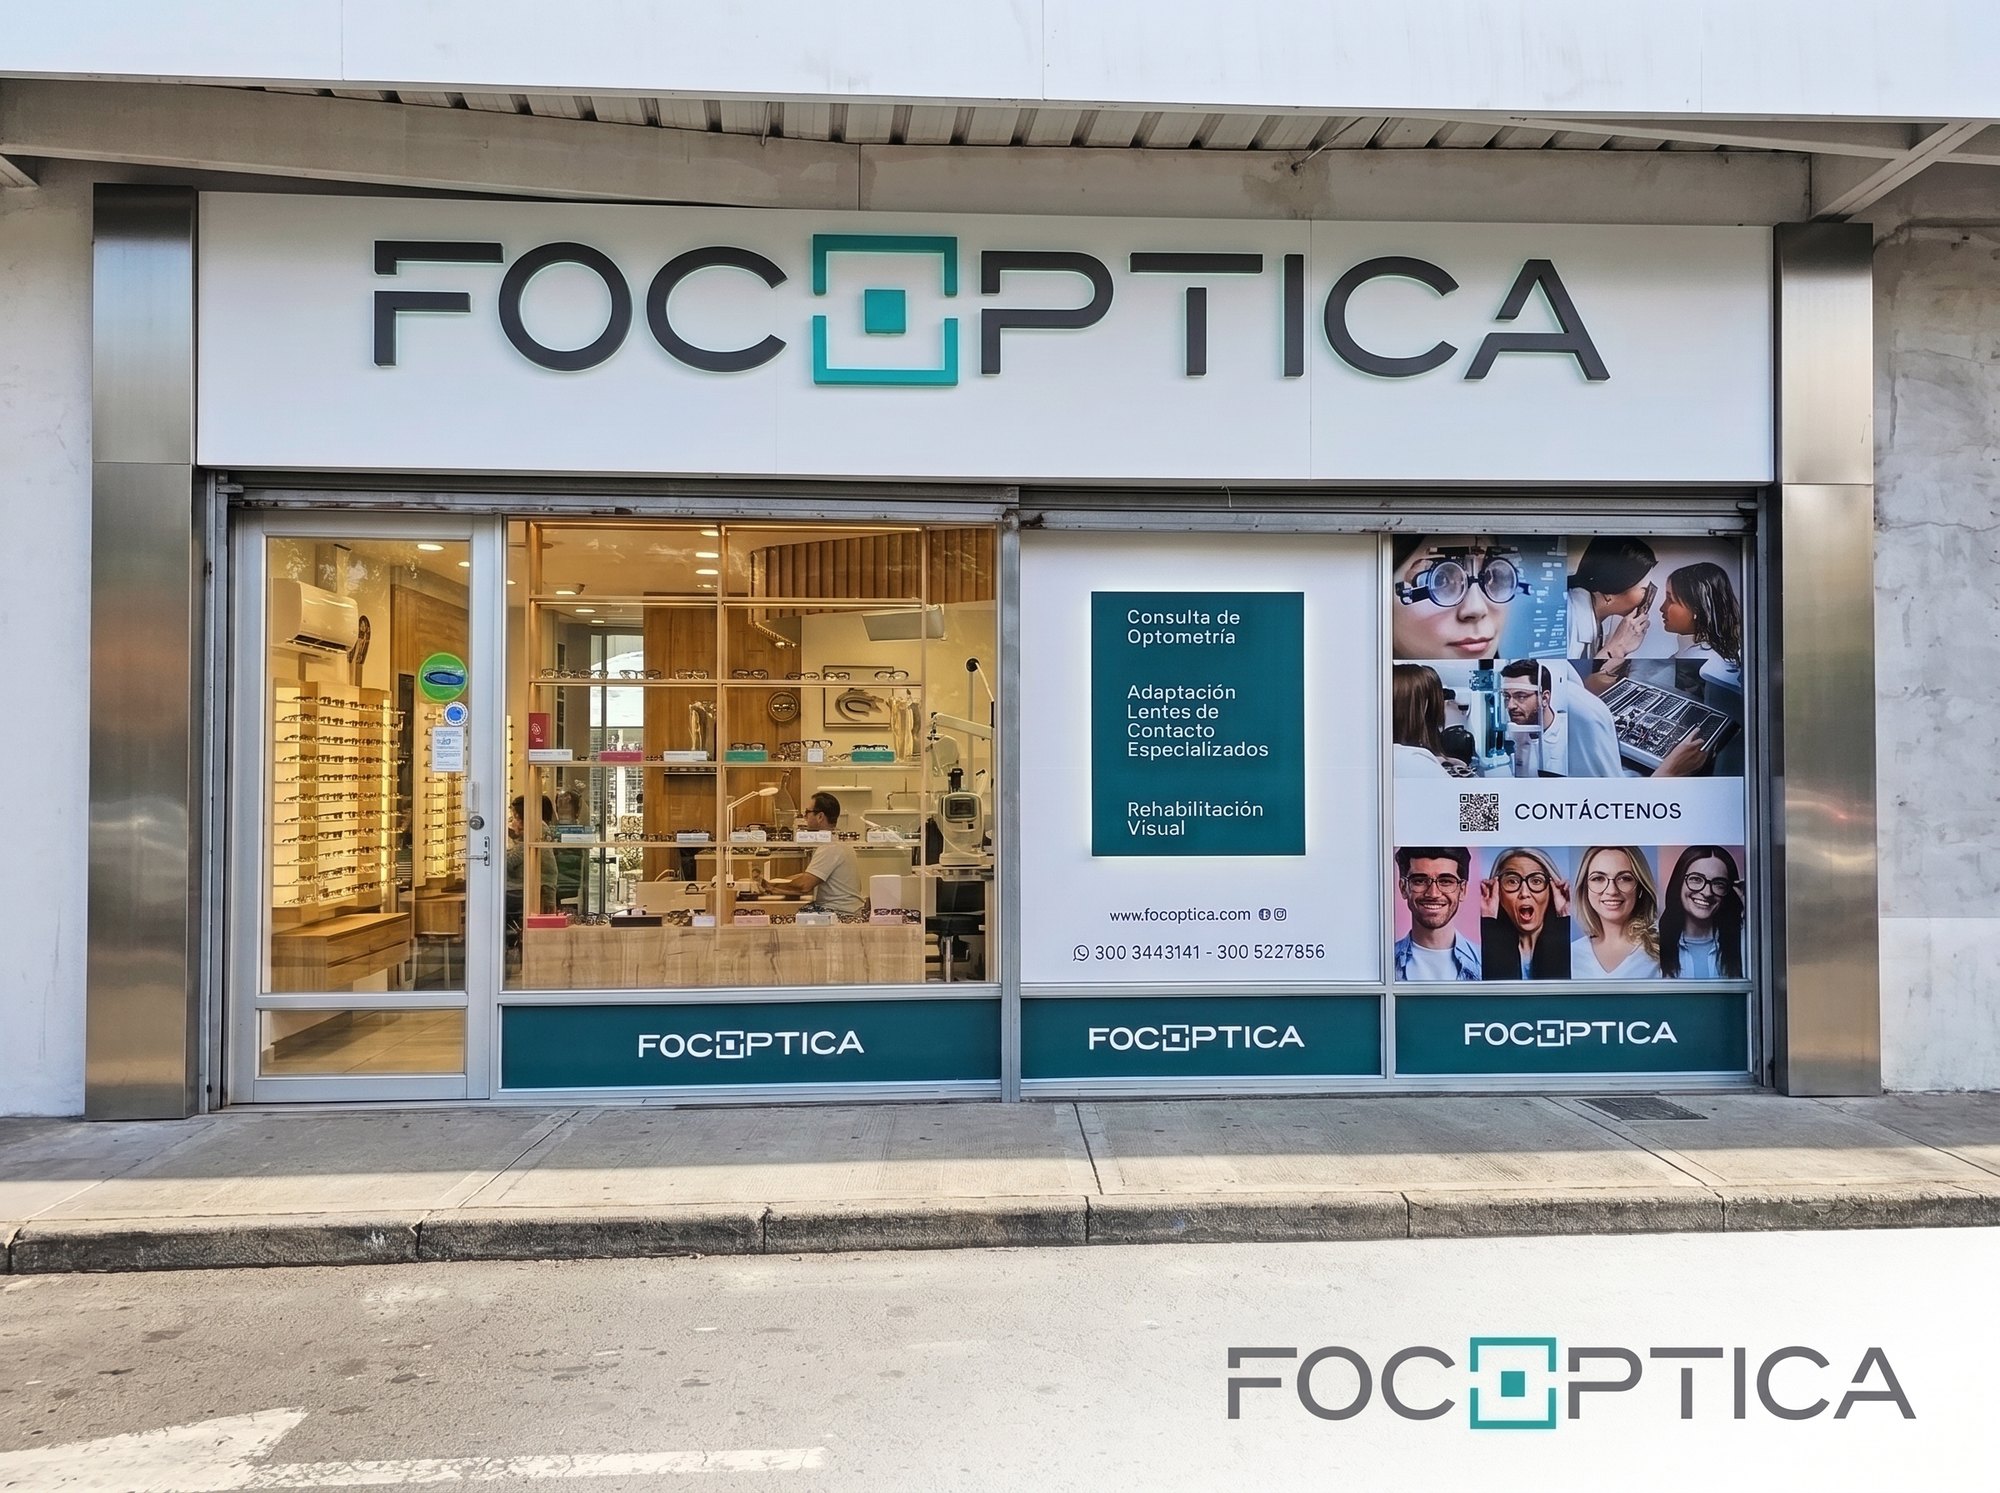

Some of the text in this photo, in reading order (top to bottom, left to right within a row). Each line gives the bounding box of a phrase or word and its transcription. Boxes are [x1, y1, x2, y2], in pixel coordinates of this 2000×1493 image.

[1127, 609, 1241, 625] Consulta de
[1127, 628, 1236, 648] Optometría
[1127, 683, 1236, 703] Adaptación
[1127, 703, 1219, 719] Lentes de
[1127, 722, 1215, 738] Contacto
[1128, 740, 1269, 761] Especializados
[1128, 800, 1263, 817] Rehabilitación
[1514, 797, 1683, 821] CONTÁCTENOS
[1109, 907, 1251, 925] www.focoptica.com
[1095, 945, 1127, 961] 300
[1131, 944, 1199, 960] 3443141
[1217, 944, 1249, 960] 300
[1254, 943, 1325, 959] 5227856
